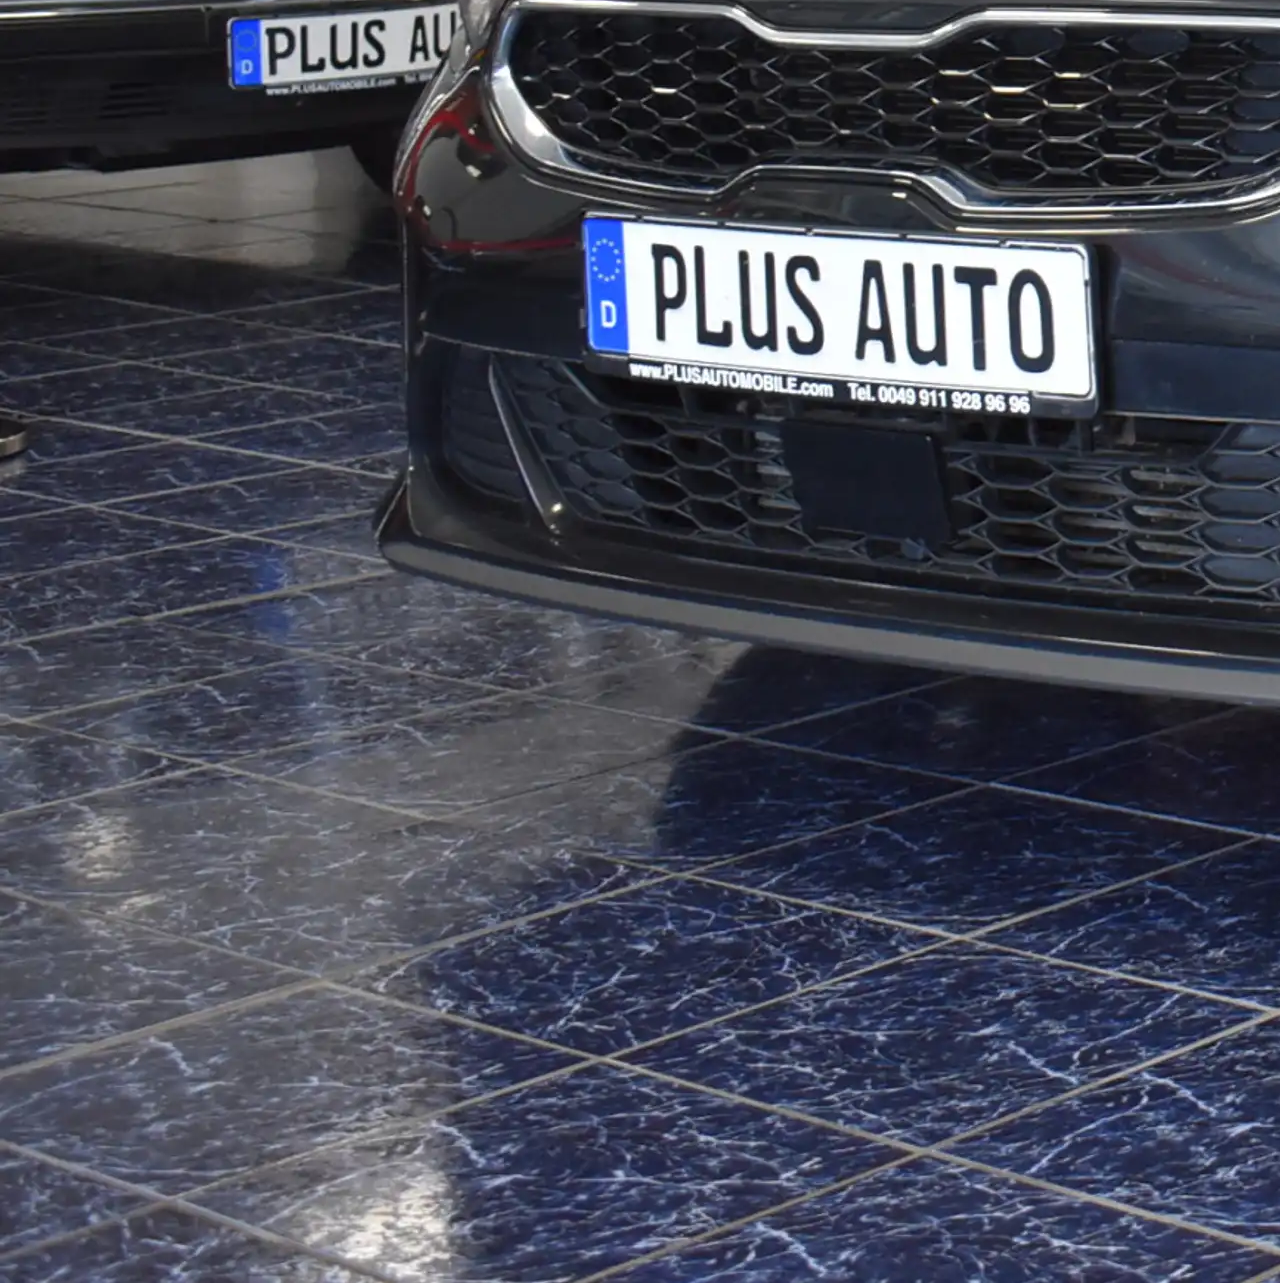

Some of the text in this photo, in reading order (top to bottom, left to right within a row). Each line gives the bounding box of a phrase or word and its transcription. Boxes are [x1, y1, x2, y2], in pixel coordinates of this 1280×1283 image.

[240, 59, 254, 75] D
[265, 10, 457, 76] PLUS AU
[600, 299, 617, 329] D
[651, 242, 1056, 374] PLUS AUTO
[628, 362, 1031, 415] www.PLUSAUTOMOBILE.com Tel. 0049 911 928 96 96
